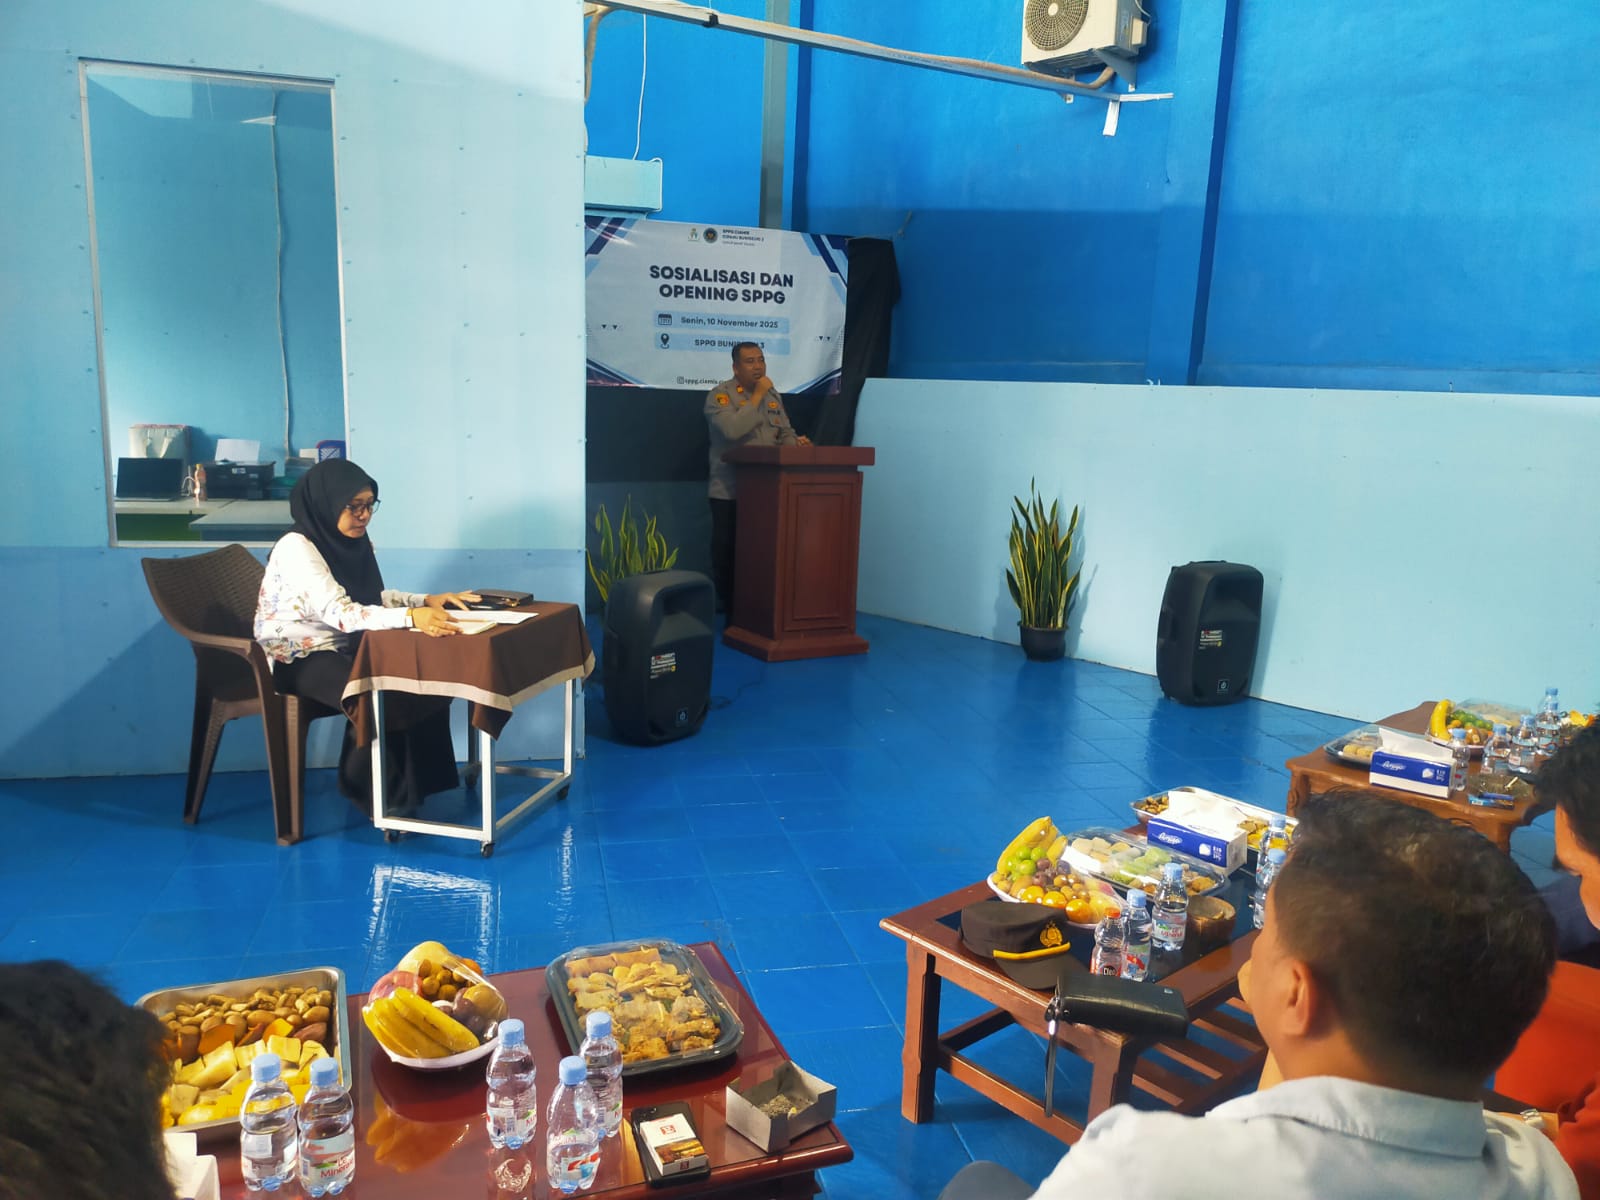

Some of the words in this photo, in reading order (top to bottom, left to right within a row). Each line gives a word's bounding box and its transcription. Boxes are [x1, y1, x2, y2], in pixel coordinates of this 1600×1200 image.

[649, 265, 756, 285] SOSIALISASI
[759, 272, 794, 288] DAN
[659, 284, 739, 302] OPENING
[741, 289, 786, 304] SPPG
[681, 316, 706, 326] Senin,
[718, 319, 757, 327] November
[759, 320, 778, 328] 2025
[694, 339, 716, 347] SPPG
